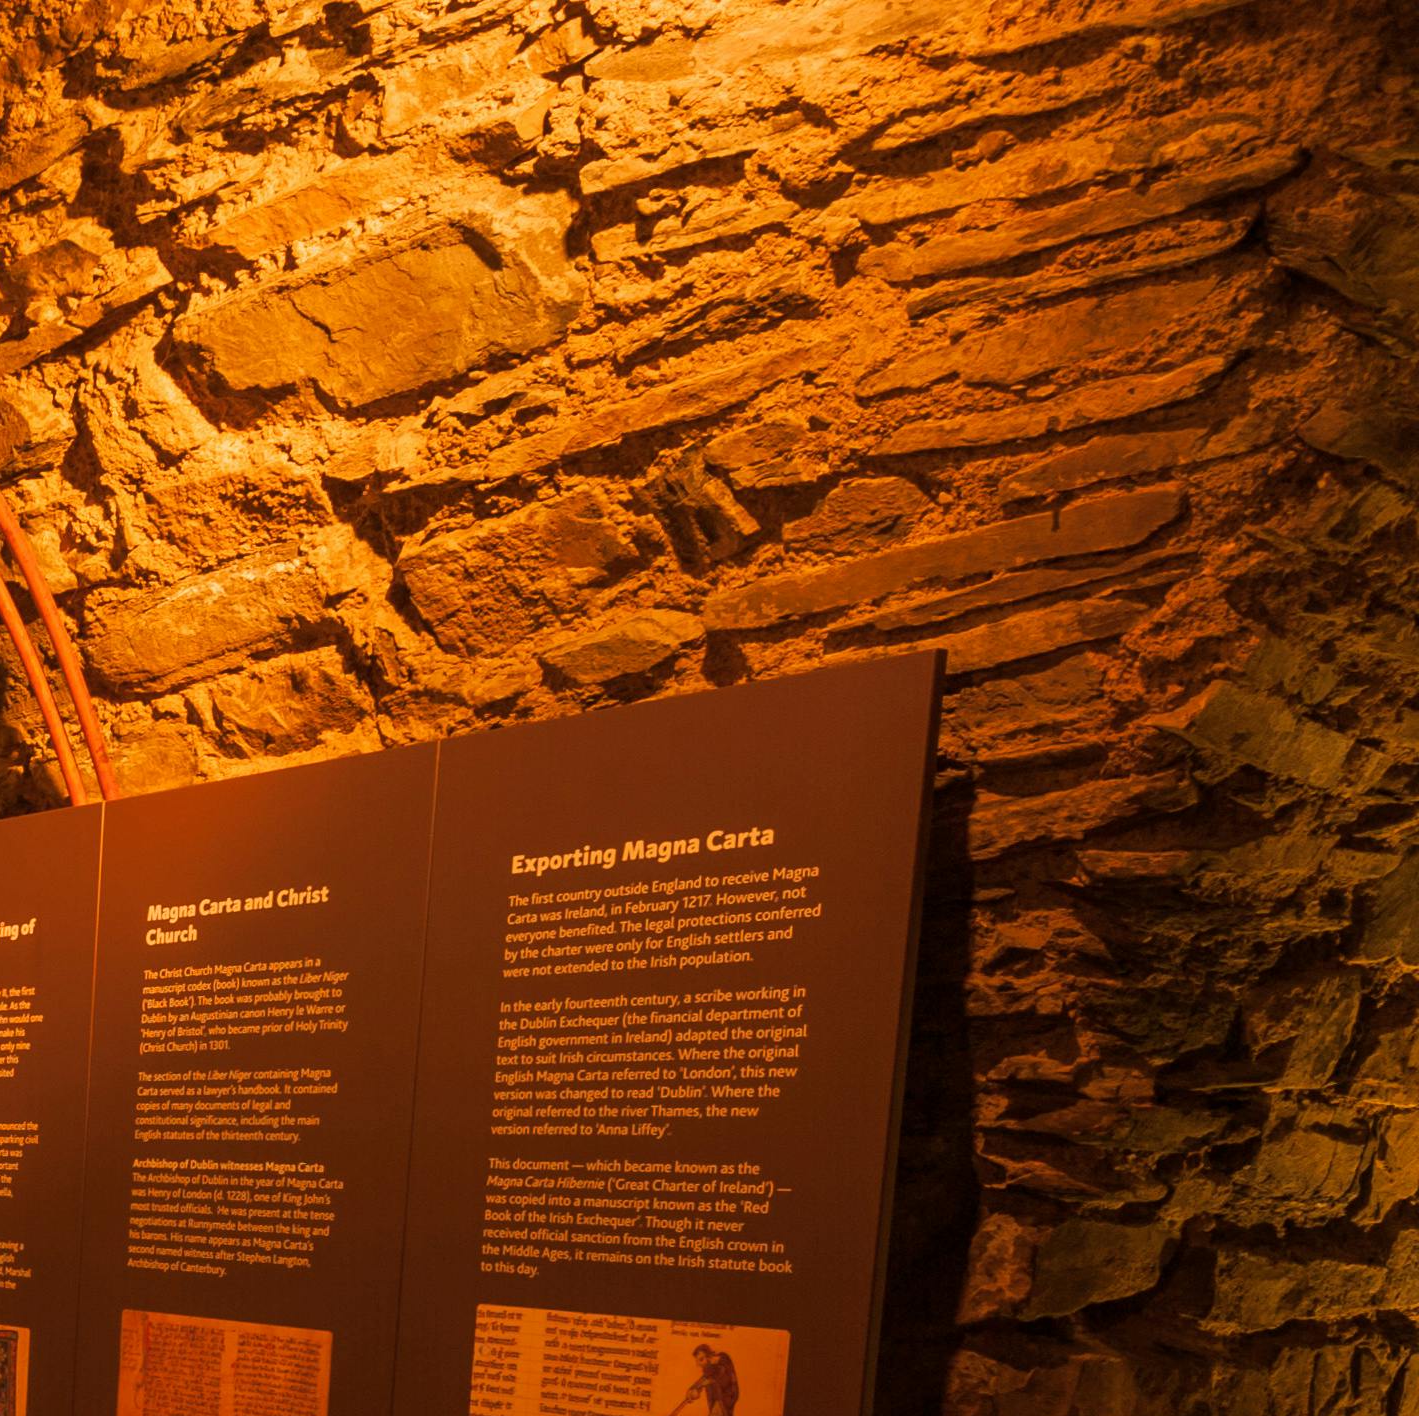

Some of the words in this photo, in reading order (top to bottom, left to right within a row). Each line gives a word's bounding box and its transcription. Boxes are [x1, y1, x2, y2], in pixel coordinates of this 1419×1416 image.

[511, 845, 616, 876] Exporting
[621, 838, 700, 862] Magna
[706, 827, 774, 851] Carta
[508, 894, 529, 906] The
[531, 892, 554, 904] first
[555, 889, 602, 902] country
[603, 881, 649, 897] outside
[651, 875, 702, 894] England
[704, 876, 719, 887] to
[721, 871, 769, 885] receive
[772, 866, 819, 882] Magna
[146, 904, 196, 923] Magna
[198, 897, 241, 915] Carta
[243, 891, 273, 910] and
[276, 886, 329, 907] Christ
[506, 912, 537, 925] Carta
[539, 911, 562, 921] was
[564, 904, 607, 919] Ireland,
[610, 903, 622, 915] in
[624, 900, 679, 913] February
[781, 886, 807, 899] not
[20, 919, 36, 935] of
[145, 924, 197, 945] Church
[505, 930, 557, 944] everyone
[619, 920, 642, 932] The
[644, 916, 675, 933] legal
[677, 912, 752, 931] protections
[754, 903, 821, 921] conferred
[504, 948, 518, 963] by
[519, 942, 539, 959] the
[540, 945, 583, 957] charter
[584, 943, 614, 954] were
[615, 938, 643, 954] only
[645, 936, 664, 949] for
[666, 932, 711, 950] English
[713, 929, 764, 944] settlers
[767, 925, 793, 940] and
[143, 969, 158, 980] The
[158, 968, 183, 979] Christ
[183, 964, 213, 976] Church
[213, 964, 242, 976] Magna
[243, 961, 267, 972] Carta
[268, 960, 303, 972] appears
[304, 957, 313, 967] in
[314, 958, 321, 966] a
[502, 967, 530, 977] were
[531, 964, 552, 975] not
[553, 959, 609, 974] extended
[611, 959, 624, 970] to
[626, 956, 648, 969] the
[650, 954, 677, 967] Irish
[679, 950, 753, 969] population.
[142, 982, 186, 994] manuscript
[186, 980, 211, 991] codex
[212, 977, 239, 992] (book)
[241, 977, 270, 987] known
[271, 977, 282, 986] as
[282, 974, 298, 984] the
[298, 972, 322, 984] Liber
[322, 971, 349, 984] Niger
[197, 995, 213, 1005] The
[213, 993, 234, 1004] book
[235, 994, 253, 1003] was
[253, 990, 293, 1004] probably
[293, 987, 330, 1001] brought
[331, 988, 342, 997] to
[500, 1001, 511, 1012] In
[513, 1000, 532, 1012] the
[533, 998, 563, 1013] early
[564, 995, 627, 1009] fourteenth
[630, 994, 680, 1007] century,
[683, 994, 691, 1004] a
[694, 989, 733, 1003] scribe
[735, 986, 790, 1002] working
[792, 984, 806, 997] in
[498, 1018, 518, 1030] the
[519, 1016, 557, 1029] Dublin
[559, 1015, 620, 1029] Exchequer
[621, 1012, 648, 1028] (the
[649, 1009, 703, 1023] financial
[705, 1007, 785, 1023] department
[787, 1004, 803, 1018] of
[497, 1035, 537, 1050] English
[537, 1034, 609, 1049] government
[611, 1032, 622, 1044] in
[625, 1029, 672, 1044] Ireland)
[674, 1027, 728, 1044] adapted
[731, 1026, 753, 1039] the
[755, 1024, 807, 1042] original
[496, 1049, 519, 1065] text
[520, 1054, 533, 1064] to
[535, 1048, 557, 1064] suit
[559, 1051, 584, 1063] Irish
[677, 1047, 721, 1060] Where
[722, 1046, 745, 1059] the
[747, 1044, 799, 1062] original
[494, 1070, 534, 1086] English
[535, 1070, 574, 1084] Magna
[576, 1069, 609, 1081] Carta
[611, 1067, 660, 1080] referred
[662, 1068, 676, 1079] to
[739, 1064, 765, 1078] this
[768, 1067, 798, 1077] new
[493, 1084, 533, 1100] version
[534, 1090, 557, 1099] was
[559, 1086, 609, 1102] changed
[610, 1088, 624, 1099] to
[626, 1086, 654, 1098] read
[710, 1084, 755, 1097] Where
[757, 1084, 781, 1097] the
[491, 1105, 533, 1120] original
[535, 1104, 581, 1117] referred
[583, 1106, 596, 1117] to
[598, 1104, 618, 1117] the
[620, 1104, 649, 1117] river
[650, 1104, 702, 1118] Thames,
[705, 1104, 728, 1117] the
[730, 1106, 759, 1116] new
[490, 1123, 530, 1135] version
[532, 1122, 578, 1135] referred
[579, 1124, 593, 1135] to
[132, 1158, 178, 1171] Archbishop
[179, 1158, 189, 1169] of
[189, 1159, 219, 1170] Dublin
[219, 1160, 263, 1171] witnesses
[264, 1161, 296, 1174] Magna
[297, 1162, 324, 1172] Carta
